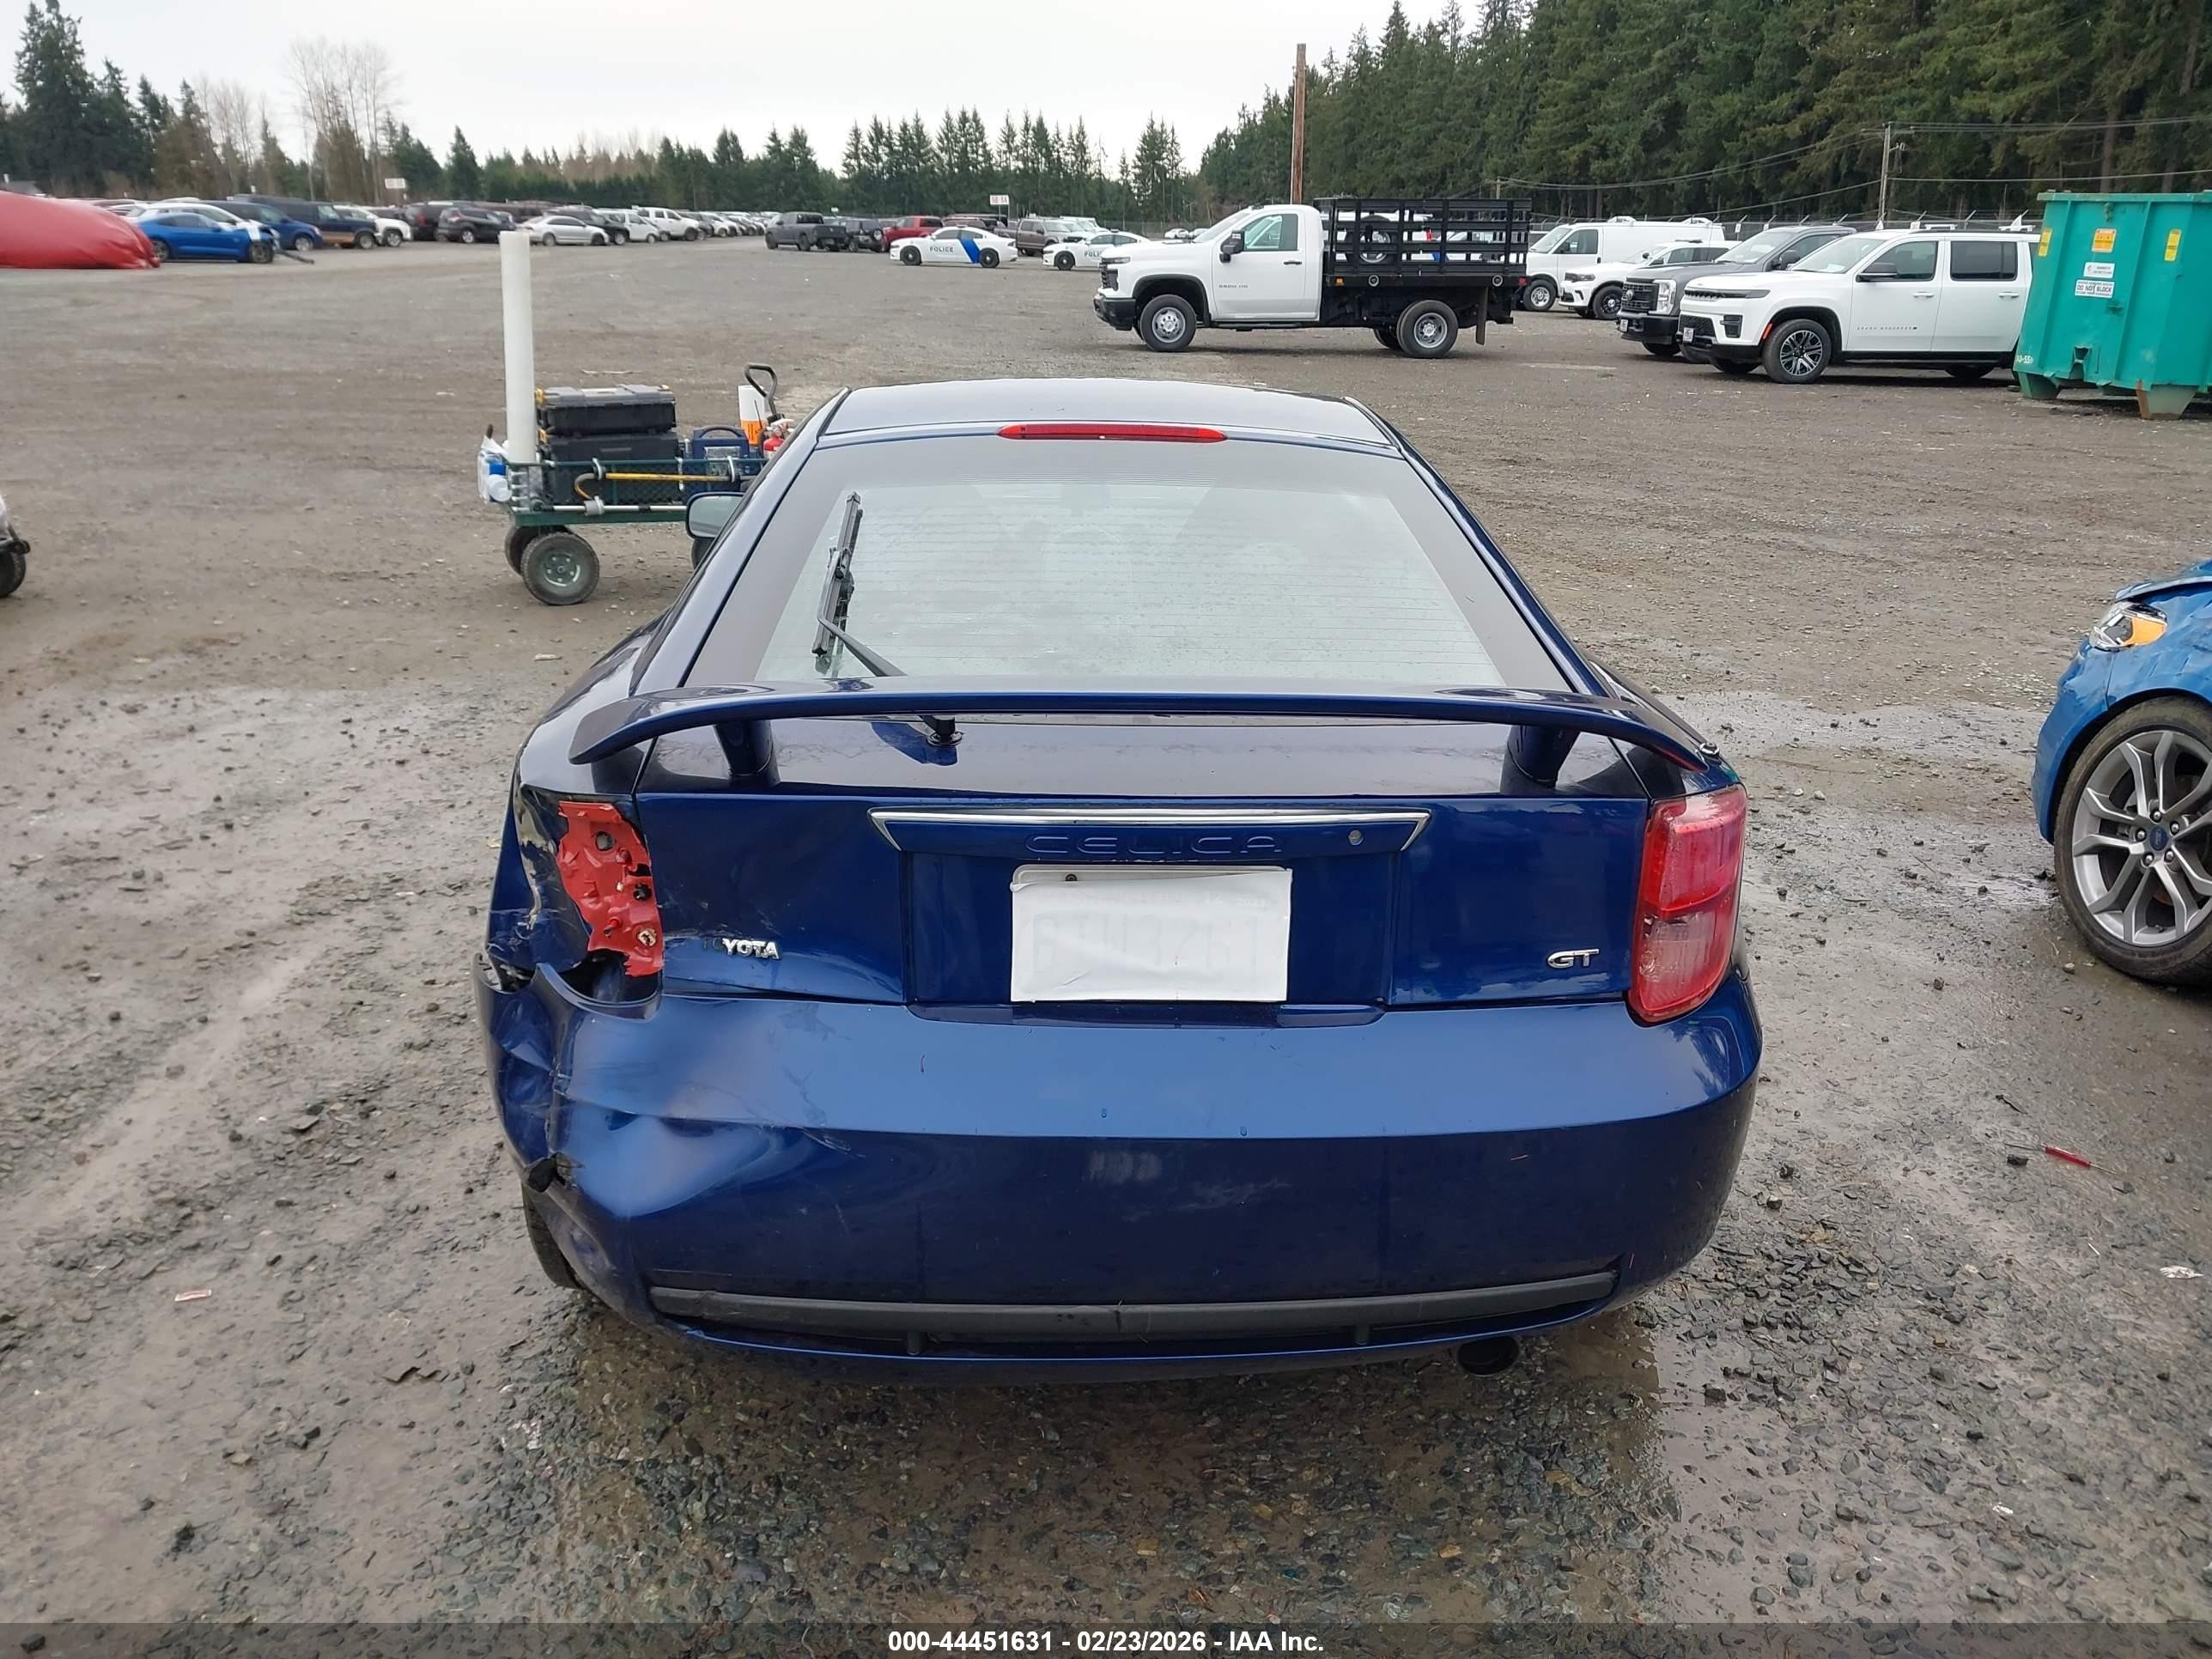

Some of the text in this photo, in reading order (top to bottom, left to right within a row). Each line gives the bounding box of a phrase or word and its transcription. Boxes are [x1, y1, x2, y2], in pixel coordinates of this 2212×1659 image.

[1025, 836, 1281, 854] CELICA
[722, 938, 780, 959] YOTA
[1547, 948, 1600, 969] GT
